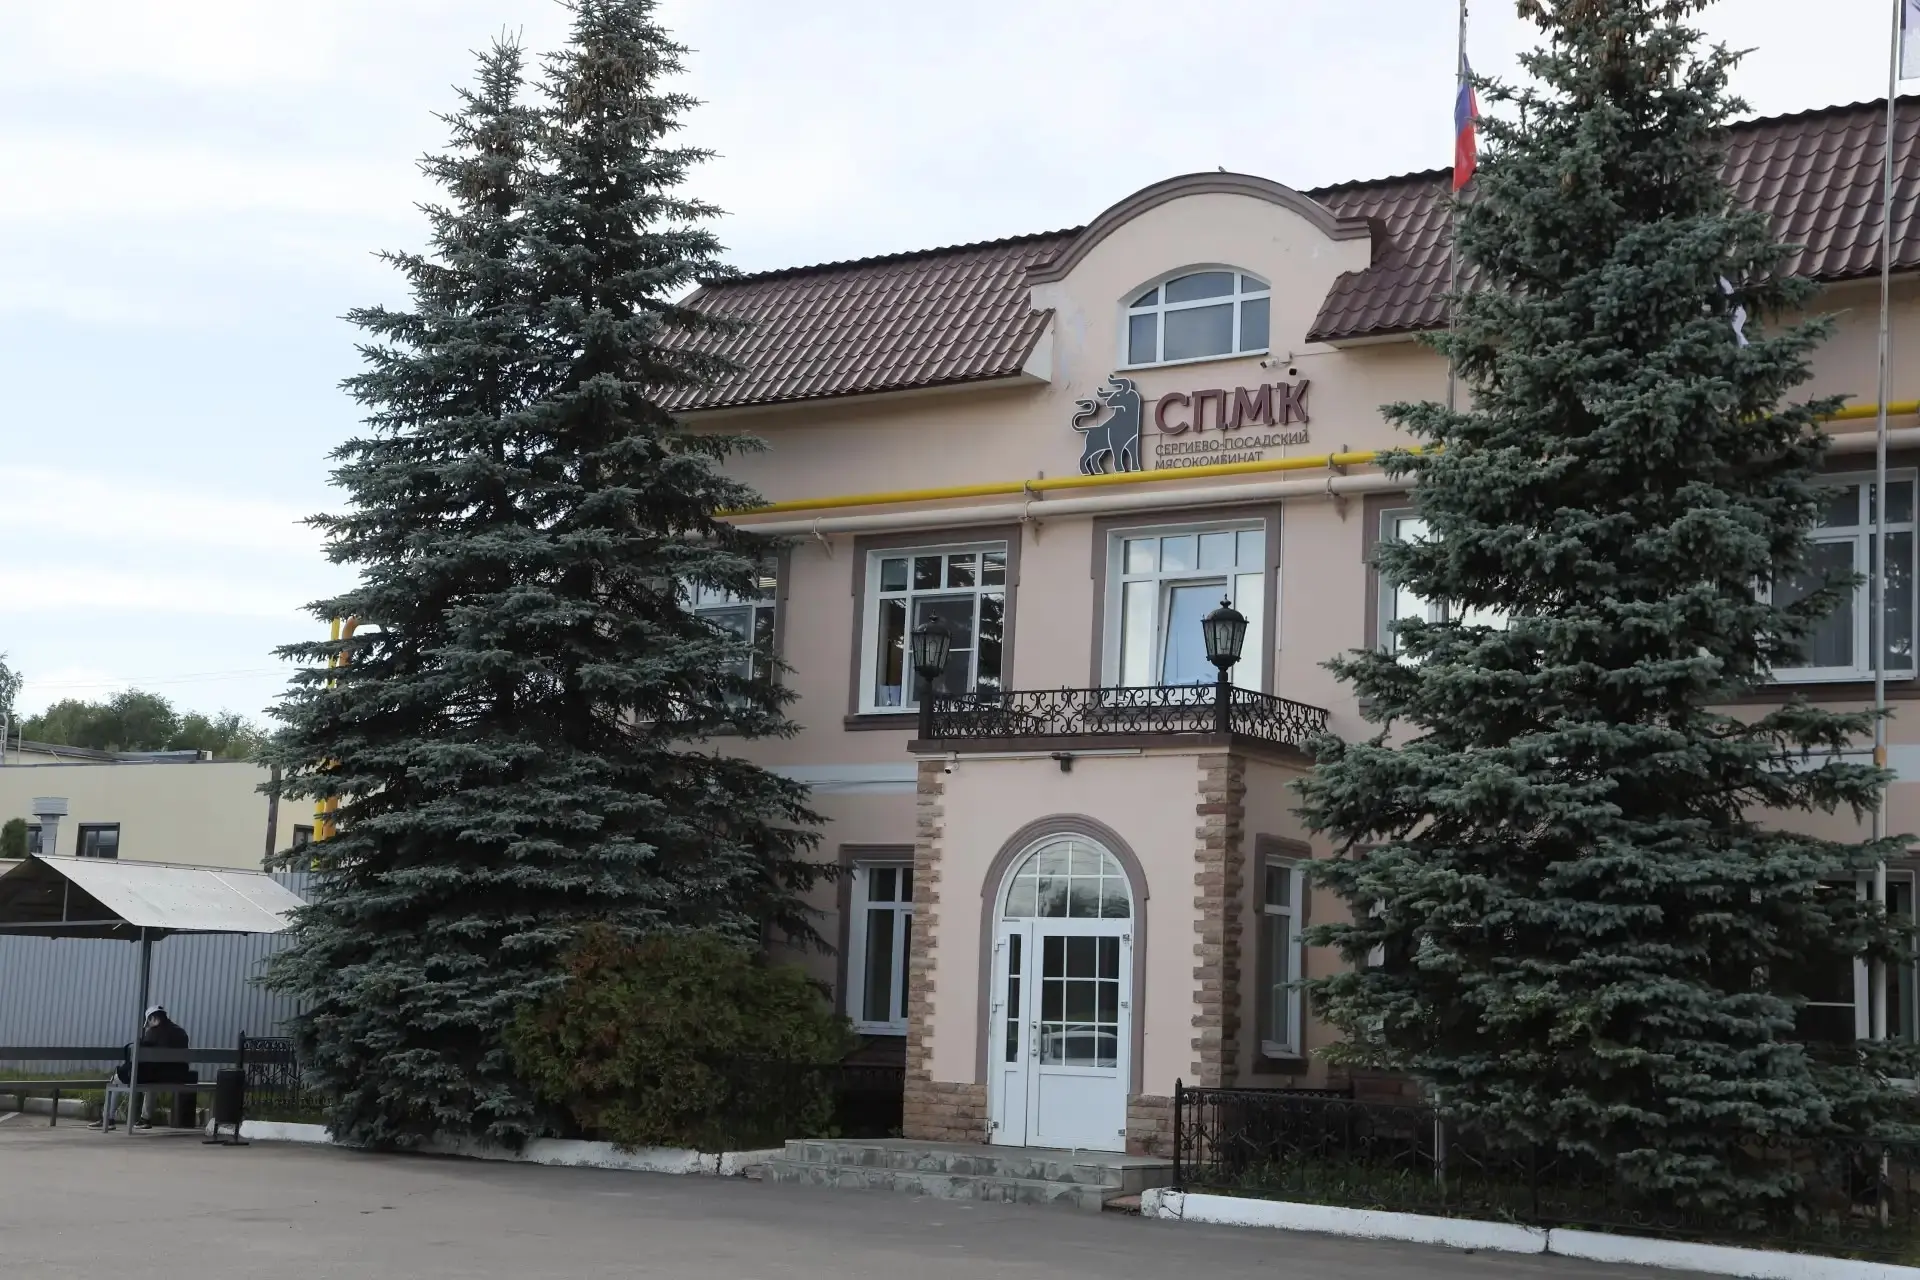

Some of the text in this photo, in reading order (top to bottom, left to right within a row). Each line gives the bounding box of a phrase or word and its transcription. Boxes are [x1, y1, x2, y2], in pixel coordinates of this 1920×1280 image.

[1155, 379, 1310, 435] СПМК
[1155, 429, 1309, 456] СЕРГИЕВО-ПОСАДСКИЙ
[1155, 451, 1263, 470] МЯСОКОМБИНАТ
